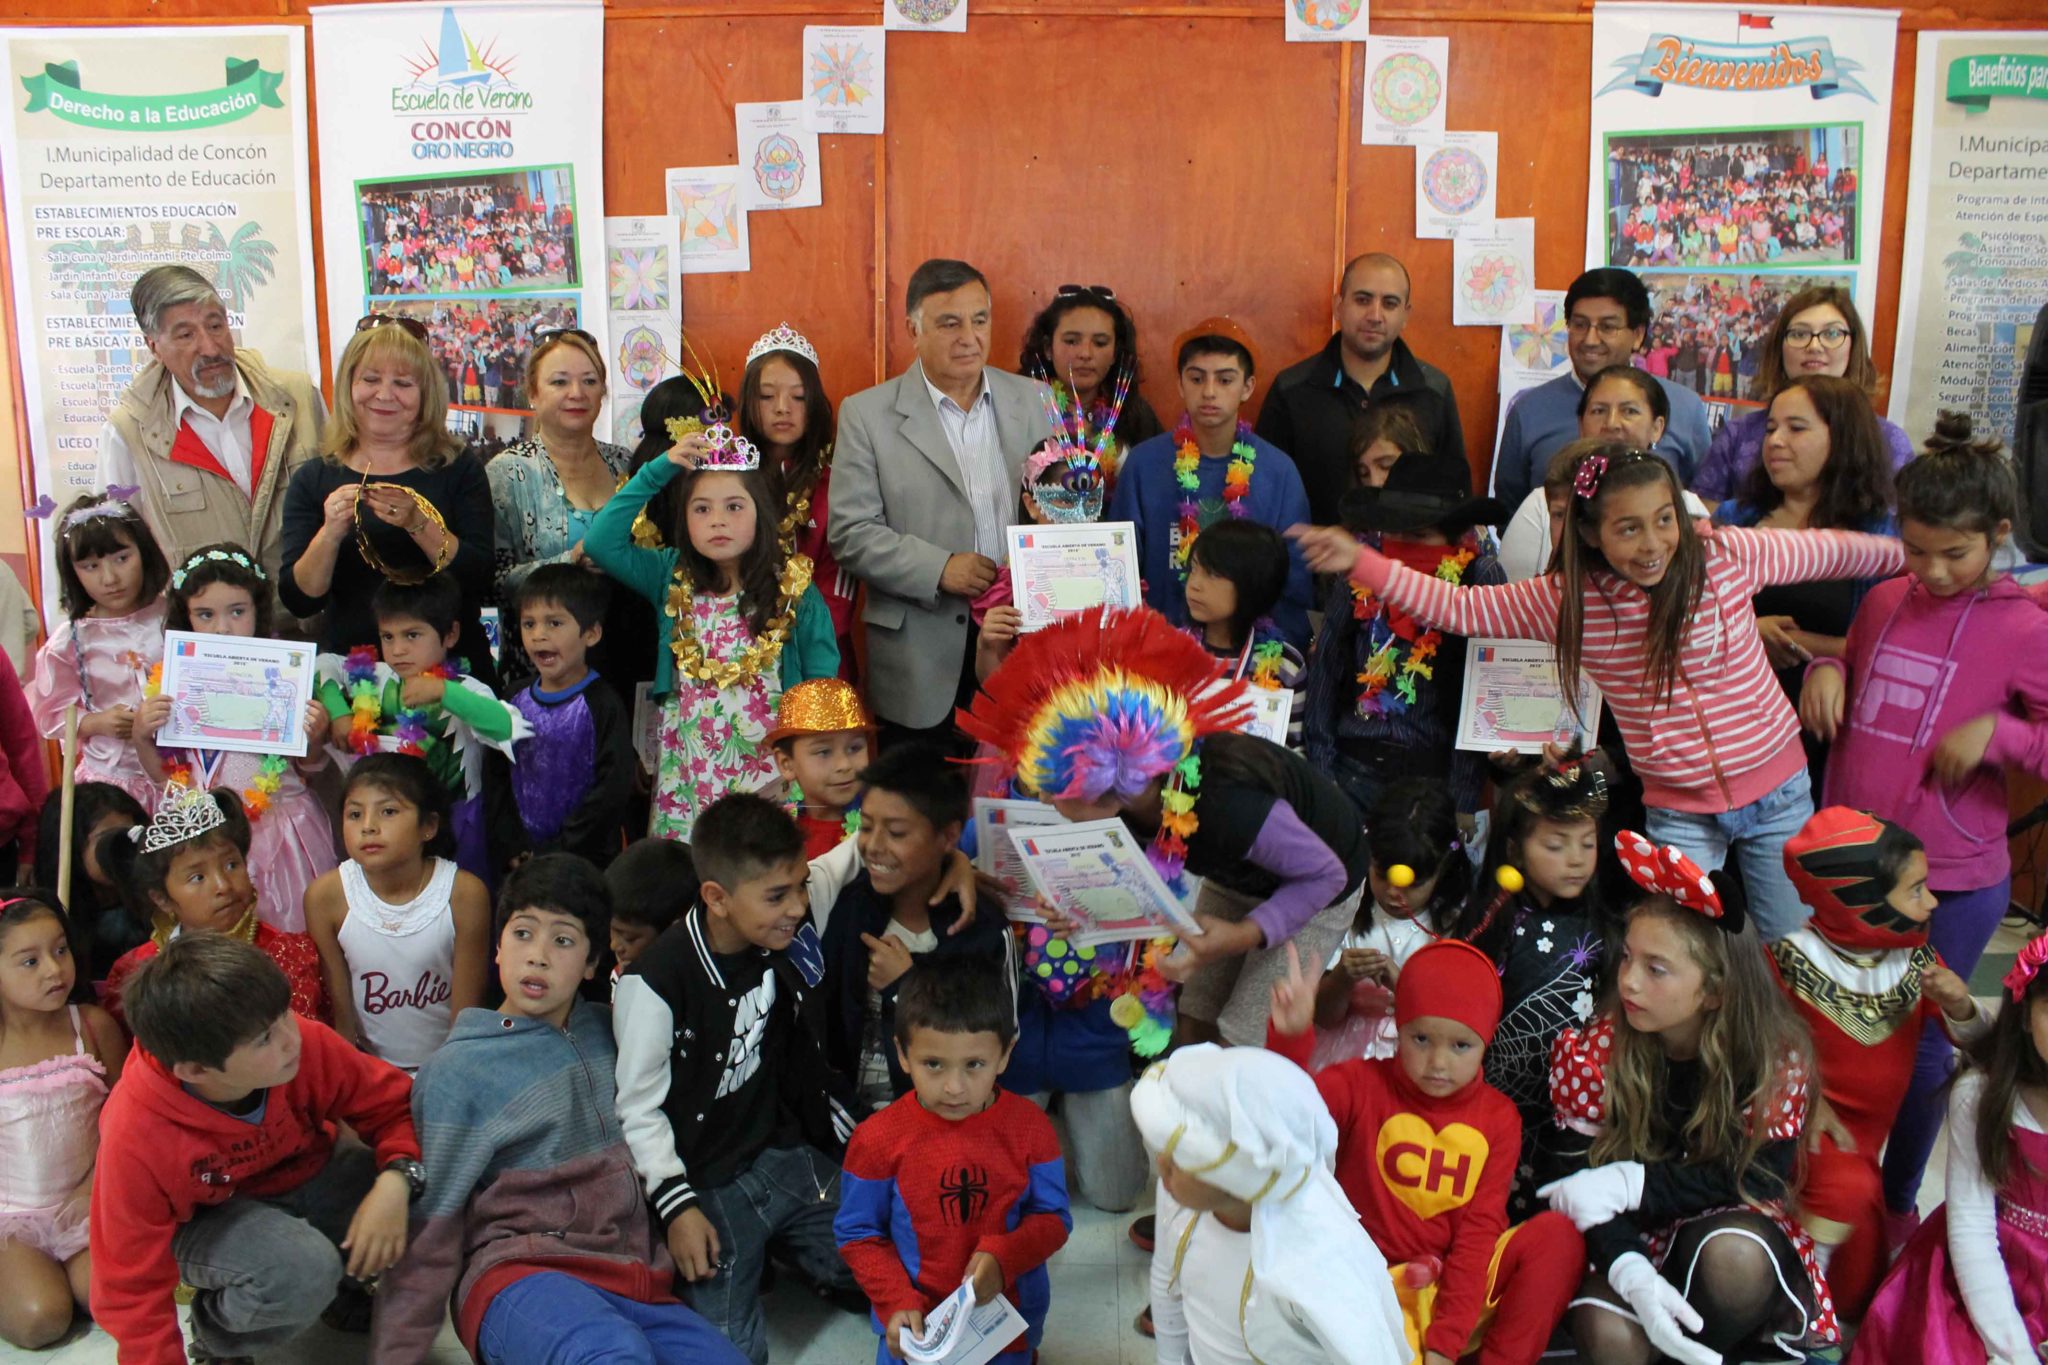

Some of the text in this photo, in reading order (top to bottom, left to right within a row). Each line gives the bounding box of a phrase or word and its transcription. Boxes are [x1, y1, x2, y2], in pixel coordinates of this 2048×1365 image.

[1650, 35, 1822, 90] Bienvenidos
[1968, 56, 2048, 95] Beneficios par
[392, 86, 533, 111] Escuela de Verano
[50, 90, 258, 124] Derecho a la Educación
[411, 117, 512, 141] CONCÓN
[412, 141, 514, 160] ORO NEGRO
[1960, 135, 2048, 157] I.Municipa
[46, 143, 268, 166] I.Municipalidad de Concón
[1949, 161, 2048, 183] Departame
[40, 168, 276, 192] Departamento de Educación
[1956, 193, 2010, 206] Programa
[2012, 195, 2028, 205] de
[35, 202, 237, 219] ESTABLECIMIENTOS EDUCACIÓN
[1955, 211, 2004, 221] Atención
[2006, 212, 2021, 221] de
[37, 226, 125, 238] PRE ESCOLAR:
[1981, 231, 2038, 243] Psicólogos
[47, 252, 68, 262] Sala
[71, 252, 97, 262] Cuna
[1979, 256, 2048, 267] Fonoaudiolo
[51, 290, 71, 300] Sala
[74, 290, 99, 300] Cuna
[110, 289, 132, 300] Jard
[46, 317, 140, 329] ESTABLECIMIEN
[1946, 326, 1978, 337] Becas
[49, 336, 71, 348] PRE
[77, 333, 119, 348] BÁSICA
[120, 335, 131, 348] Y
[1944, 343, 2016, 354] Alimentación
[58, 365, 95, 374] Escuela
[97, 364, 132, 374] Puente
[1942, 359, 1991, 370] Atención
[61, 381, 96, 391] Escuela
[1940, 375, 2019, 387] Módulo Denta
[62, 397, 98, 407] Escuela
[1938, 391, 1977, 404] Seguro
[58, 437, 93, 449] LICEO
[360, 970, 452, 1015] Barbie
[1383, 1142, 1471, 1198] CH
